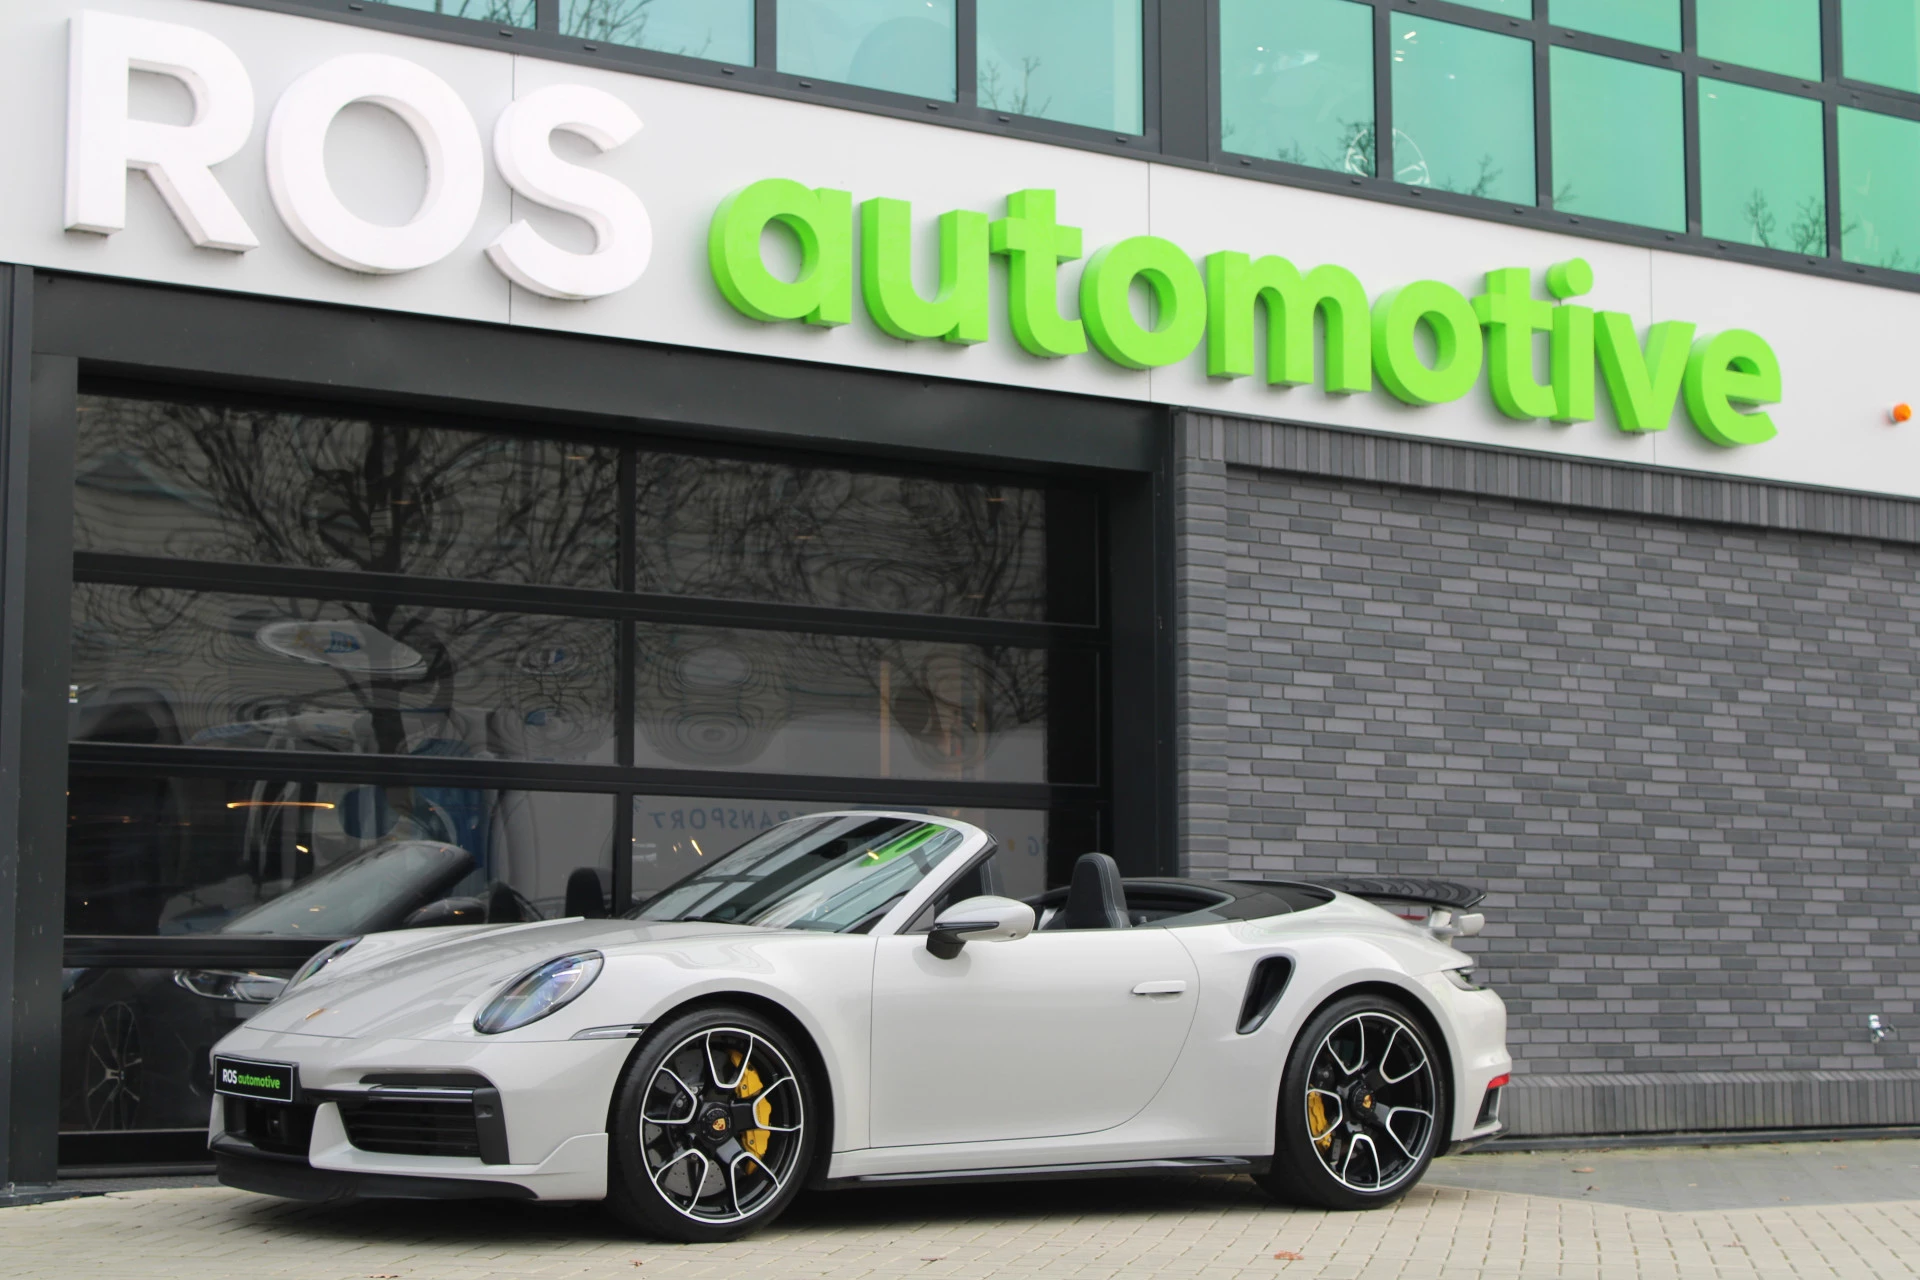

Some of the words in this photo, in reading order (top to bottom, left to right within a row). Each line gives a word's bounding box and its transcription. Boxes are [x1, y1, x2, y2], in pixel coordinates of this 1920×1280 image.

[64, 9, 653, 300] ROS
[708, 178, 1782, 448] automotive
[222, 1069, 237, 1084] ROS
[238, 1075, 280, 1088] automotive
